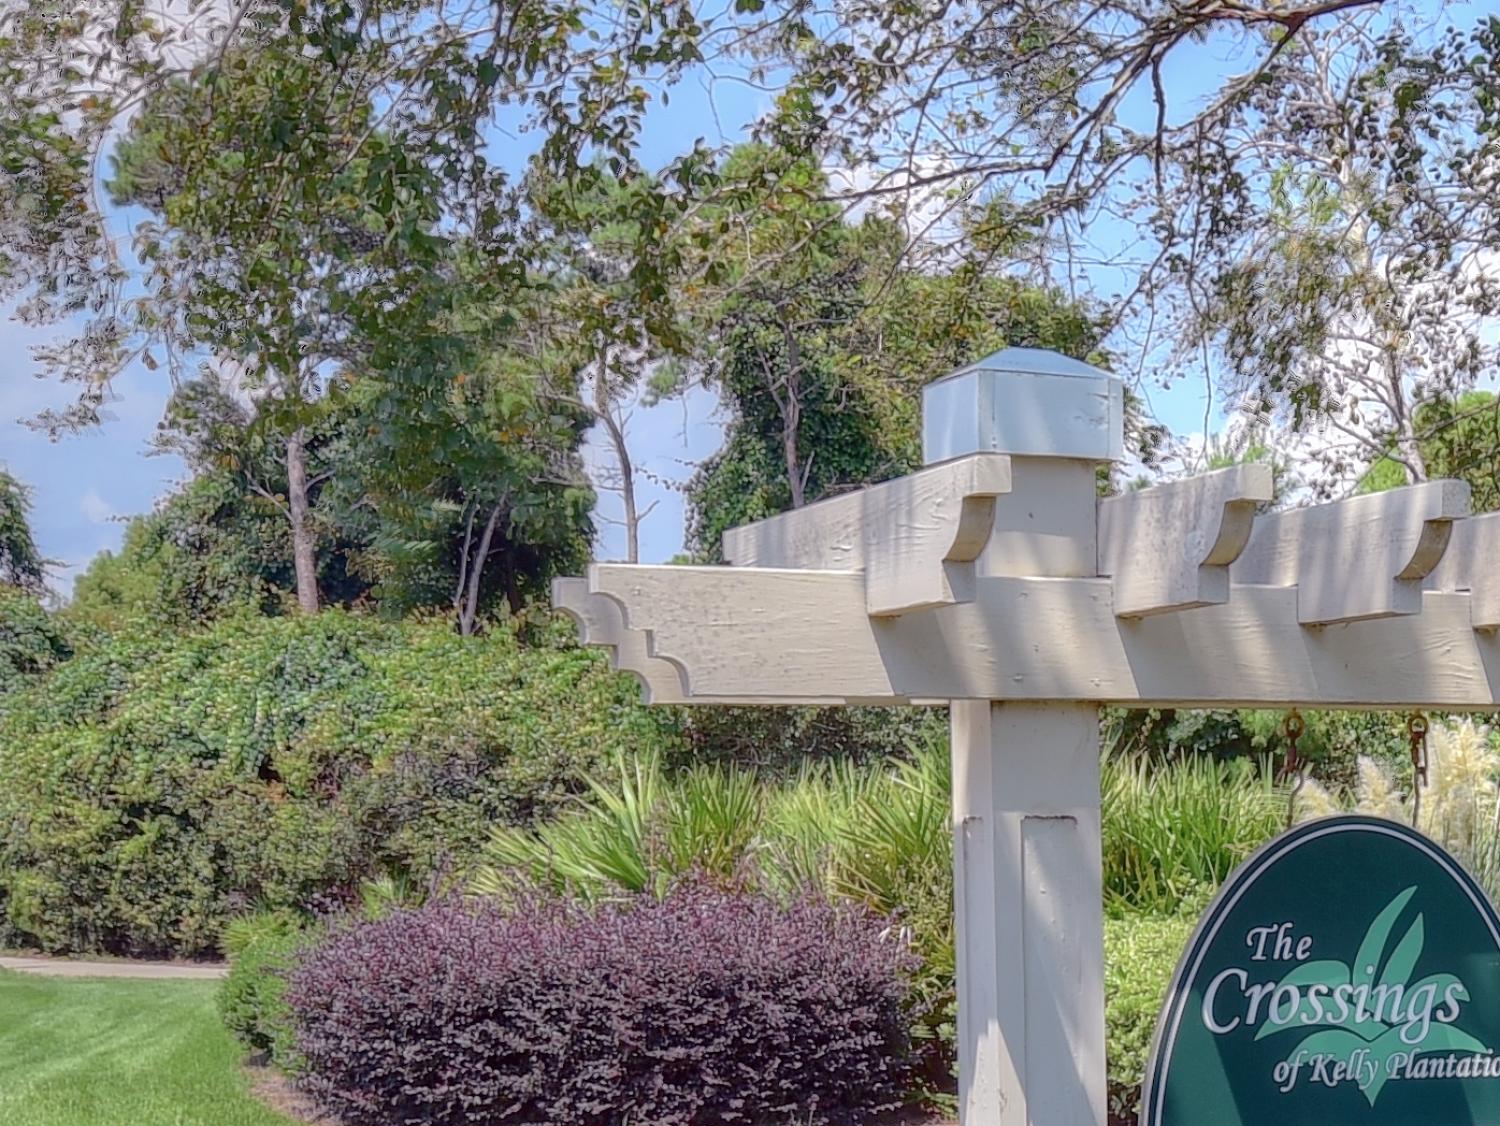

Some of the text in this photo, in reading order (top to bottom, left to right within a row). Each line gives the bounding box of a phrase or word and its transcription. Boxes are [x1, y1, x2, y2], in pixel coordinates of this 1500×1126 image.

[1247, 922, 1313, 961] The
[1202, 965, 1465, 1043] Crossings
[1273, 1053, 1307, 1093] of
[1308, 1049, 1379, 1089] Kelly
